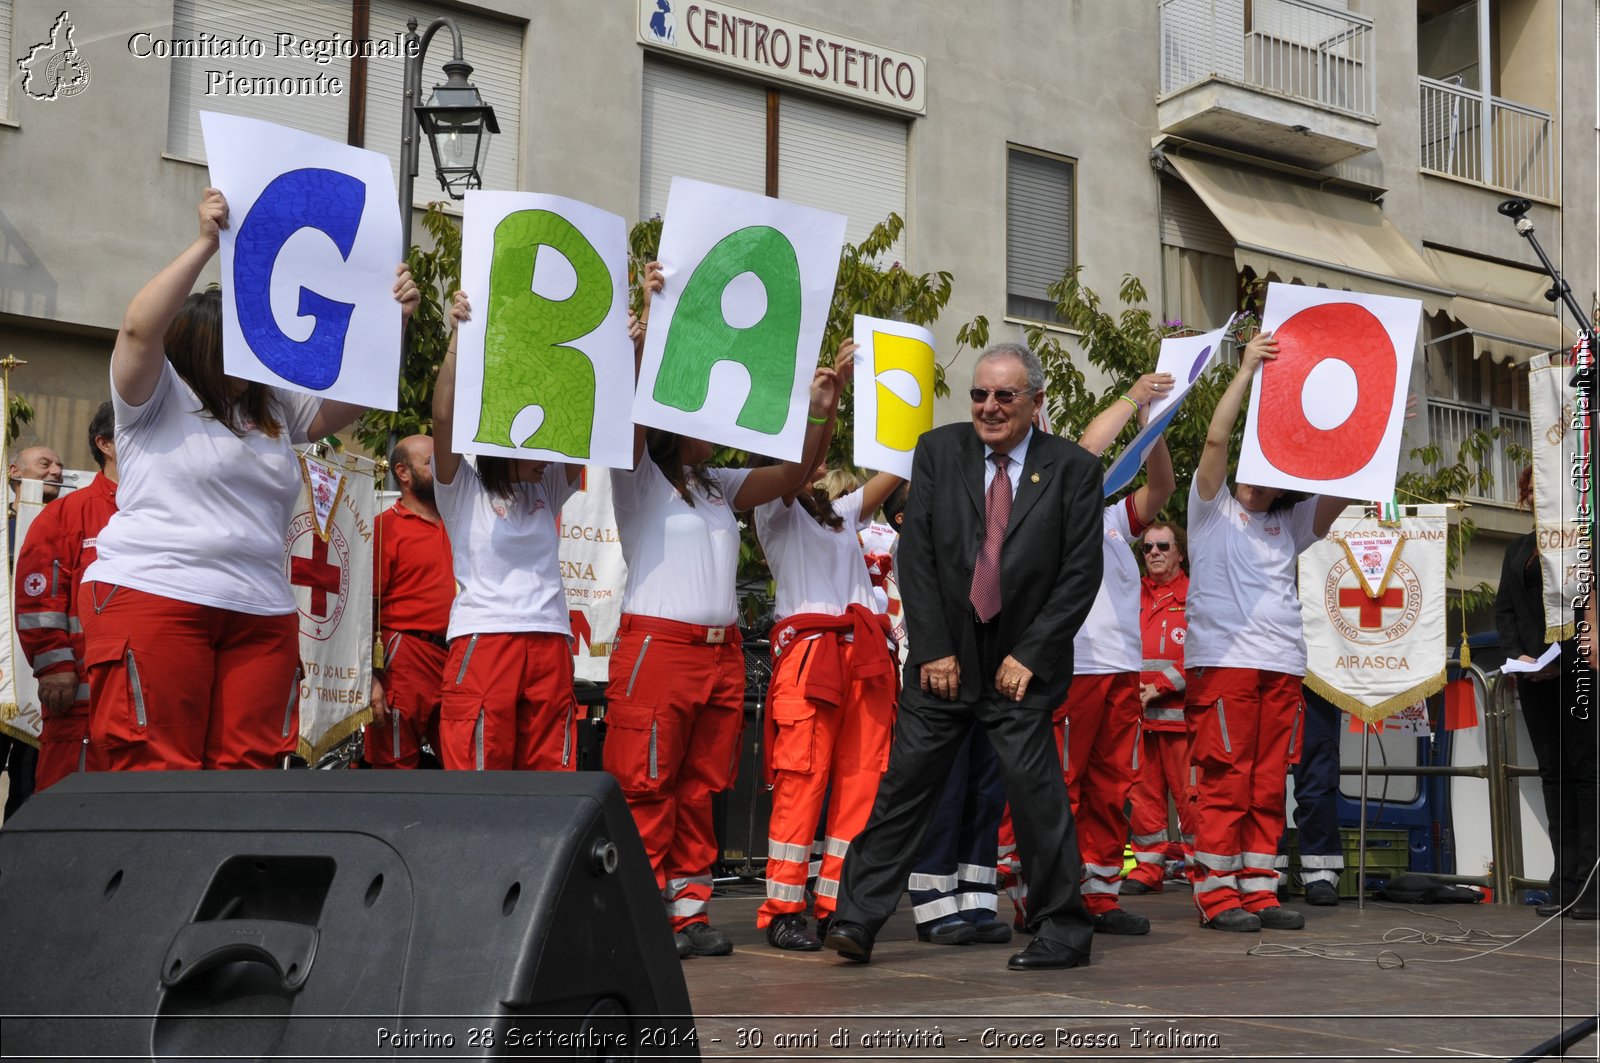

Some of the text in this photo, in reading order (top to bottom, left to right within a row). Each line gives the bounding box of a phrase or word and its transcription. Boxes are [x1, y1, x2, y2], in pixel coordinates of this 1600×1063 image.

[685, 4, 917, 101] CENTRO ESTETICO
[233, 167, 367, 391] G
[472, 208, 614, 459] R
[652, 224, 802, 436] A
[1257, 302, 1398, 481] O
[1325, 530, 1340, 541] CE
[559, 560, 597, 580] ENA
[593, 590, 612, 599] 1974
[1327, 563, 1358, 639] CONVENZIONE DI
[1384, 563, 1420, 640] 22 AGOSTO 1864
[305, 661, 320, 676] TO
[1334, 654, 1410, 671] AIRASCA
[20, 702, 43, 733] VIL
